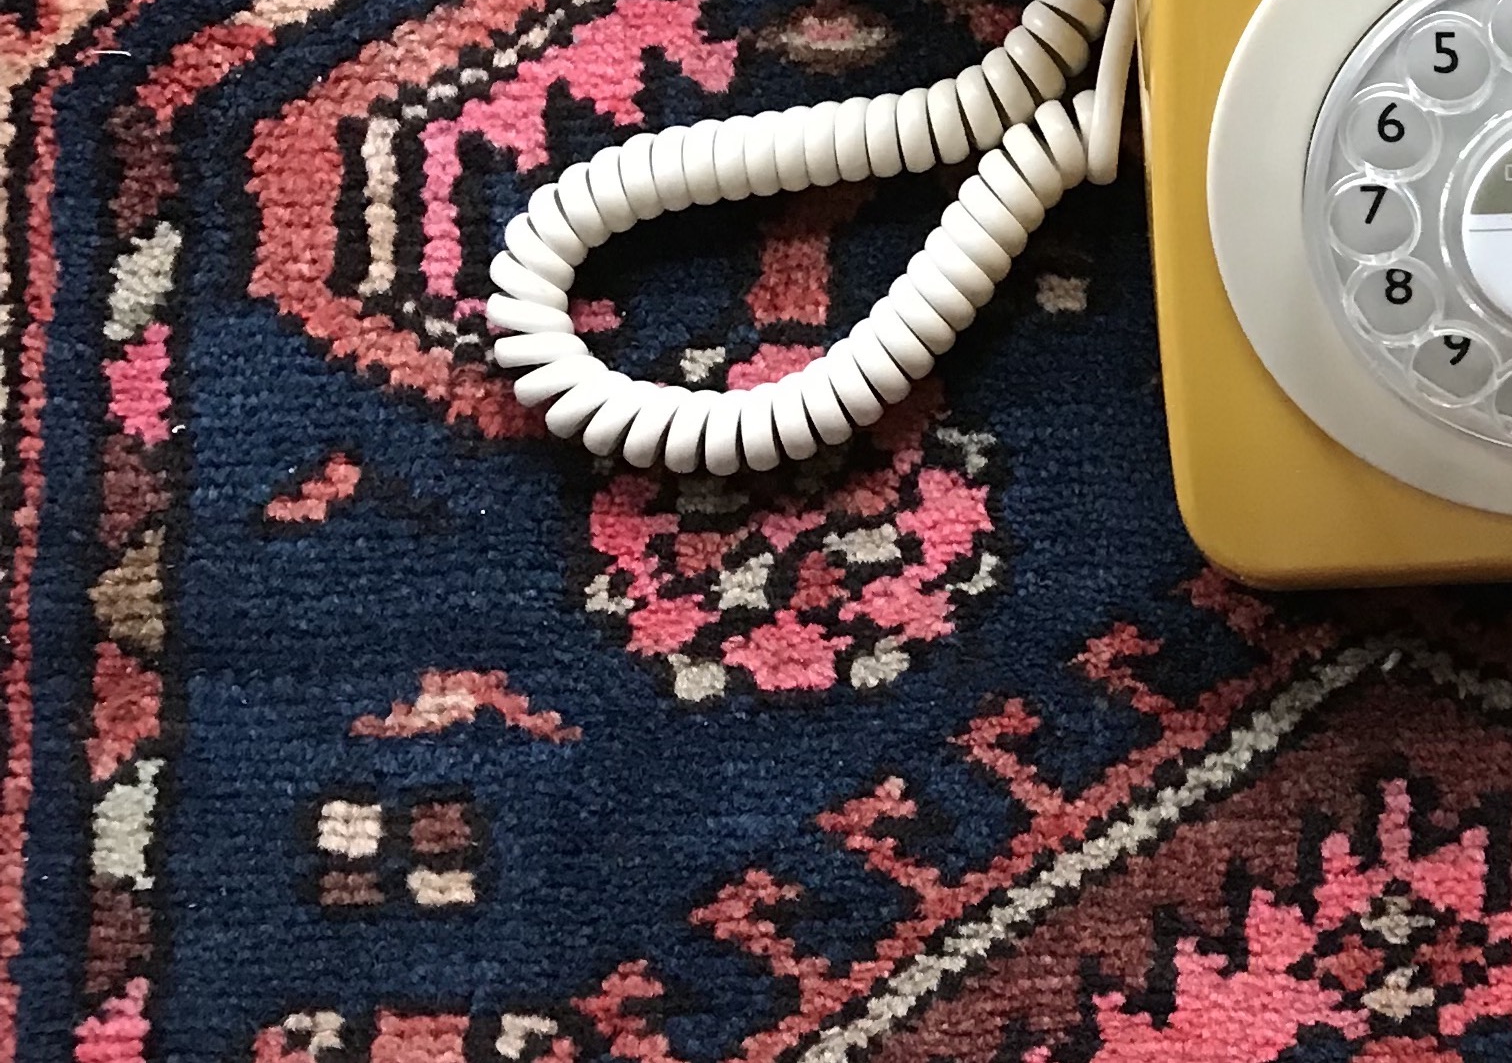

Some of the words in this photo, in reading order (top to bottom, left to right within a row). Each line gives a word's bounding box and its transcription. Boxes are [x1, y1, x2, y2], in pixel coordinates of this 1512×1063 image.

[1433, 31, 1459, 74] 5
[1377, 102, 1405, 143] 6
[1359, 184, 1389, 225] 7
[1384, 268, 1413, 306] 8
[1443, 334, 1472, 366] 9
